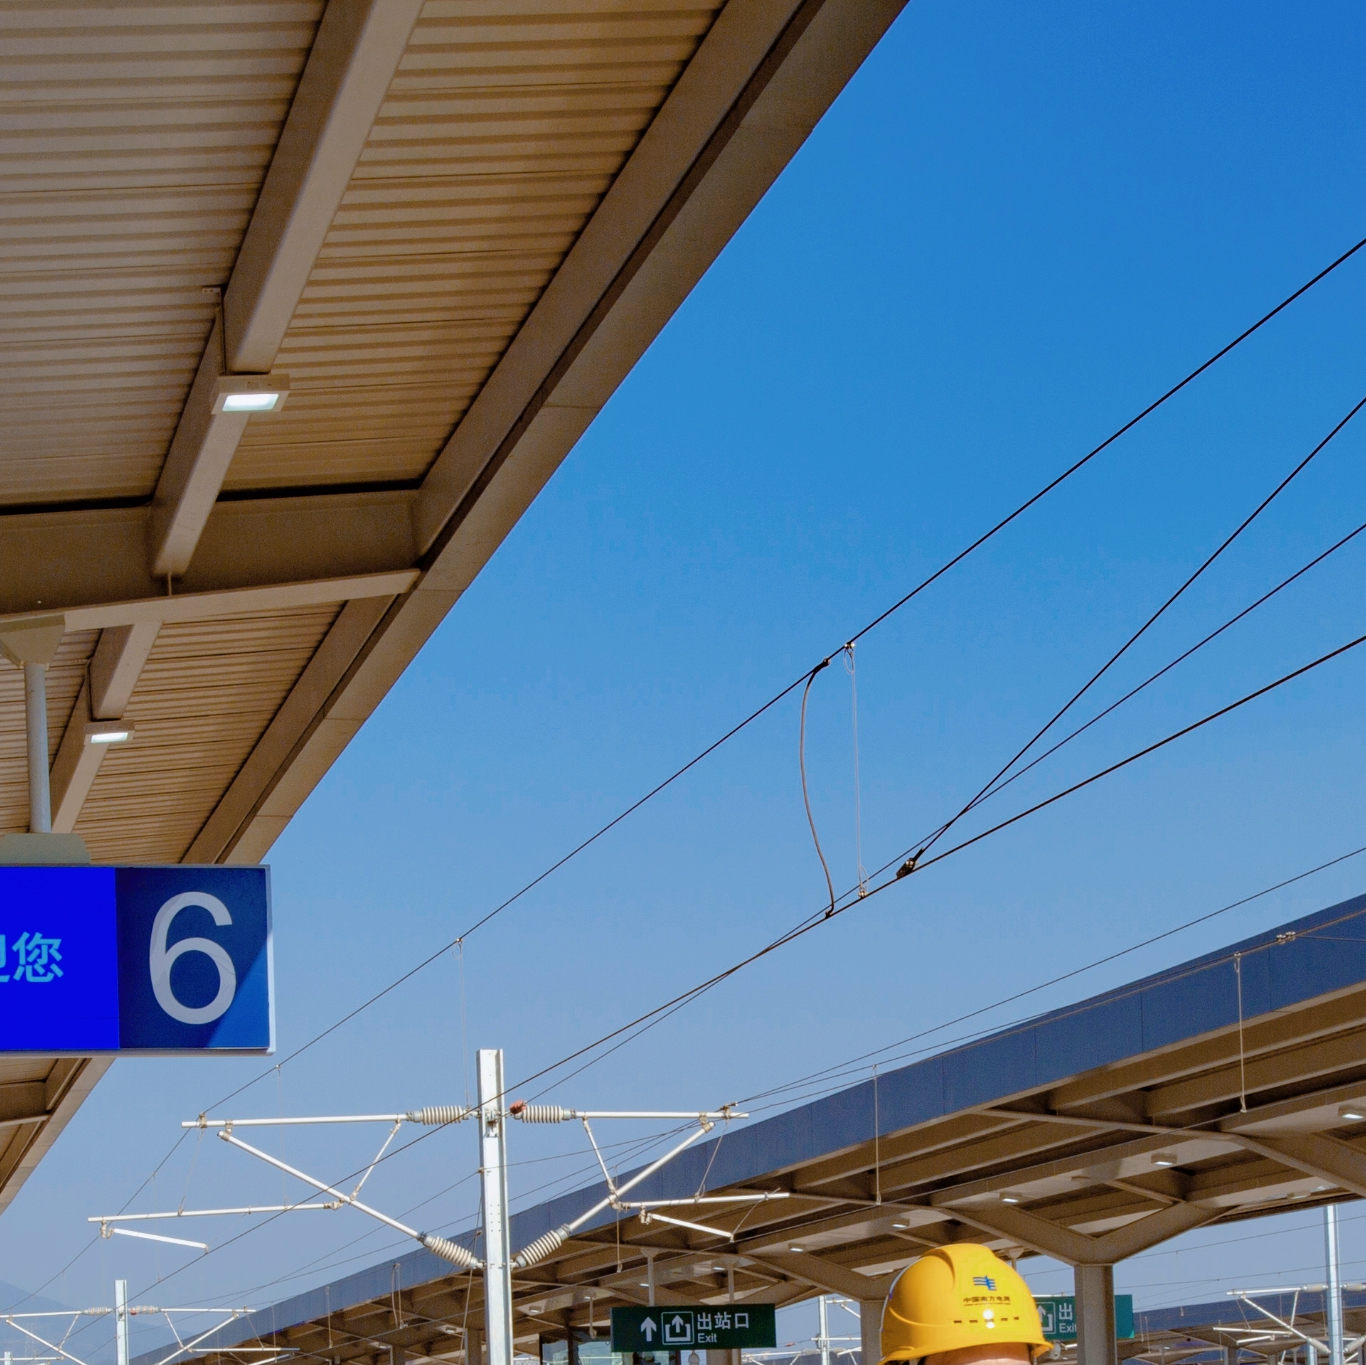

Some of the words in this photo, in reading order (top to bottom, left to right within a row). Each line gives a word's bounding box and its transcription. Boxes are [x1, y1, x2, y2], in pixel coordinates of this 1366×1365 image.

[148, 891, 236, 1025] 6
[697, 1312, 750, 1331] 出站口
[697, 1333, 718, 1344] Exit
